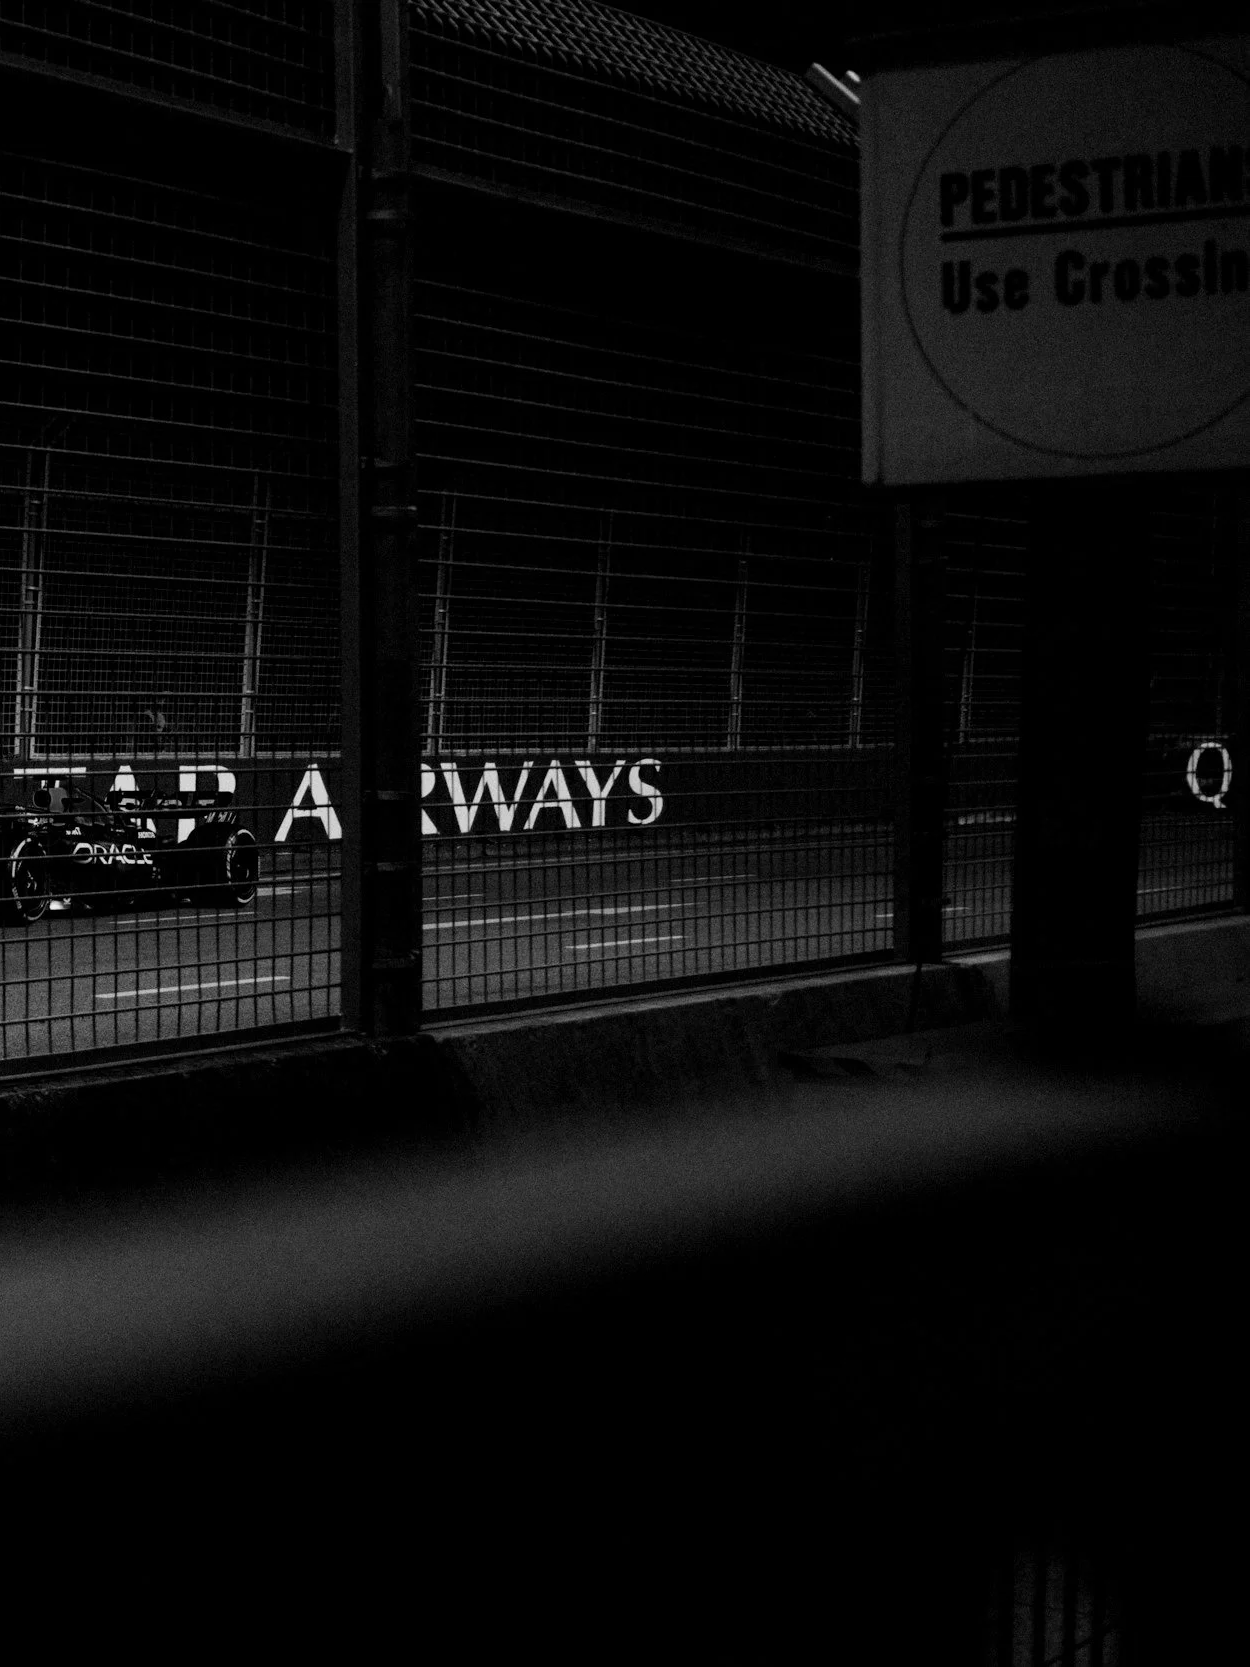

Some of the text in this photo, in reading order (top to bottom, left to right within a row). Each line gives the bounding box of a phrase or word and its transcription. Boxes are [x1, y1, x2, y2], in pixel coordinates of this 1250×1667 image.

[941, 145, 1250, 228] PEDESTRIAN
[943, 260, 1030, 314] Use
[274, 758, 664, 843] AWAYS
[72, 842, 155, 866] ORACLE
